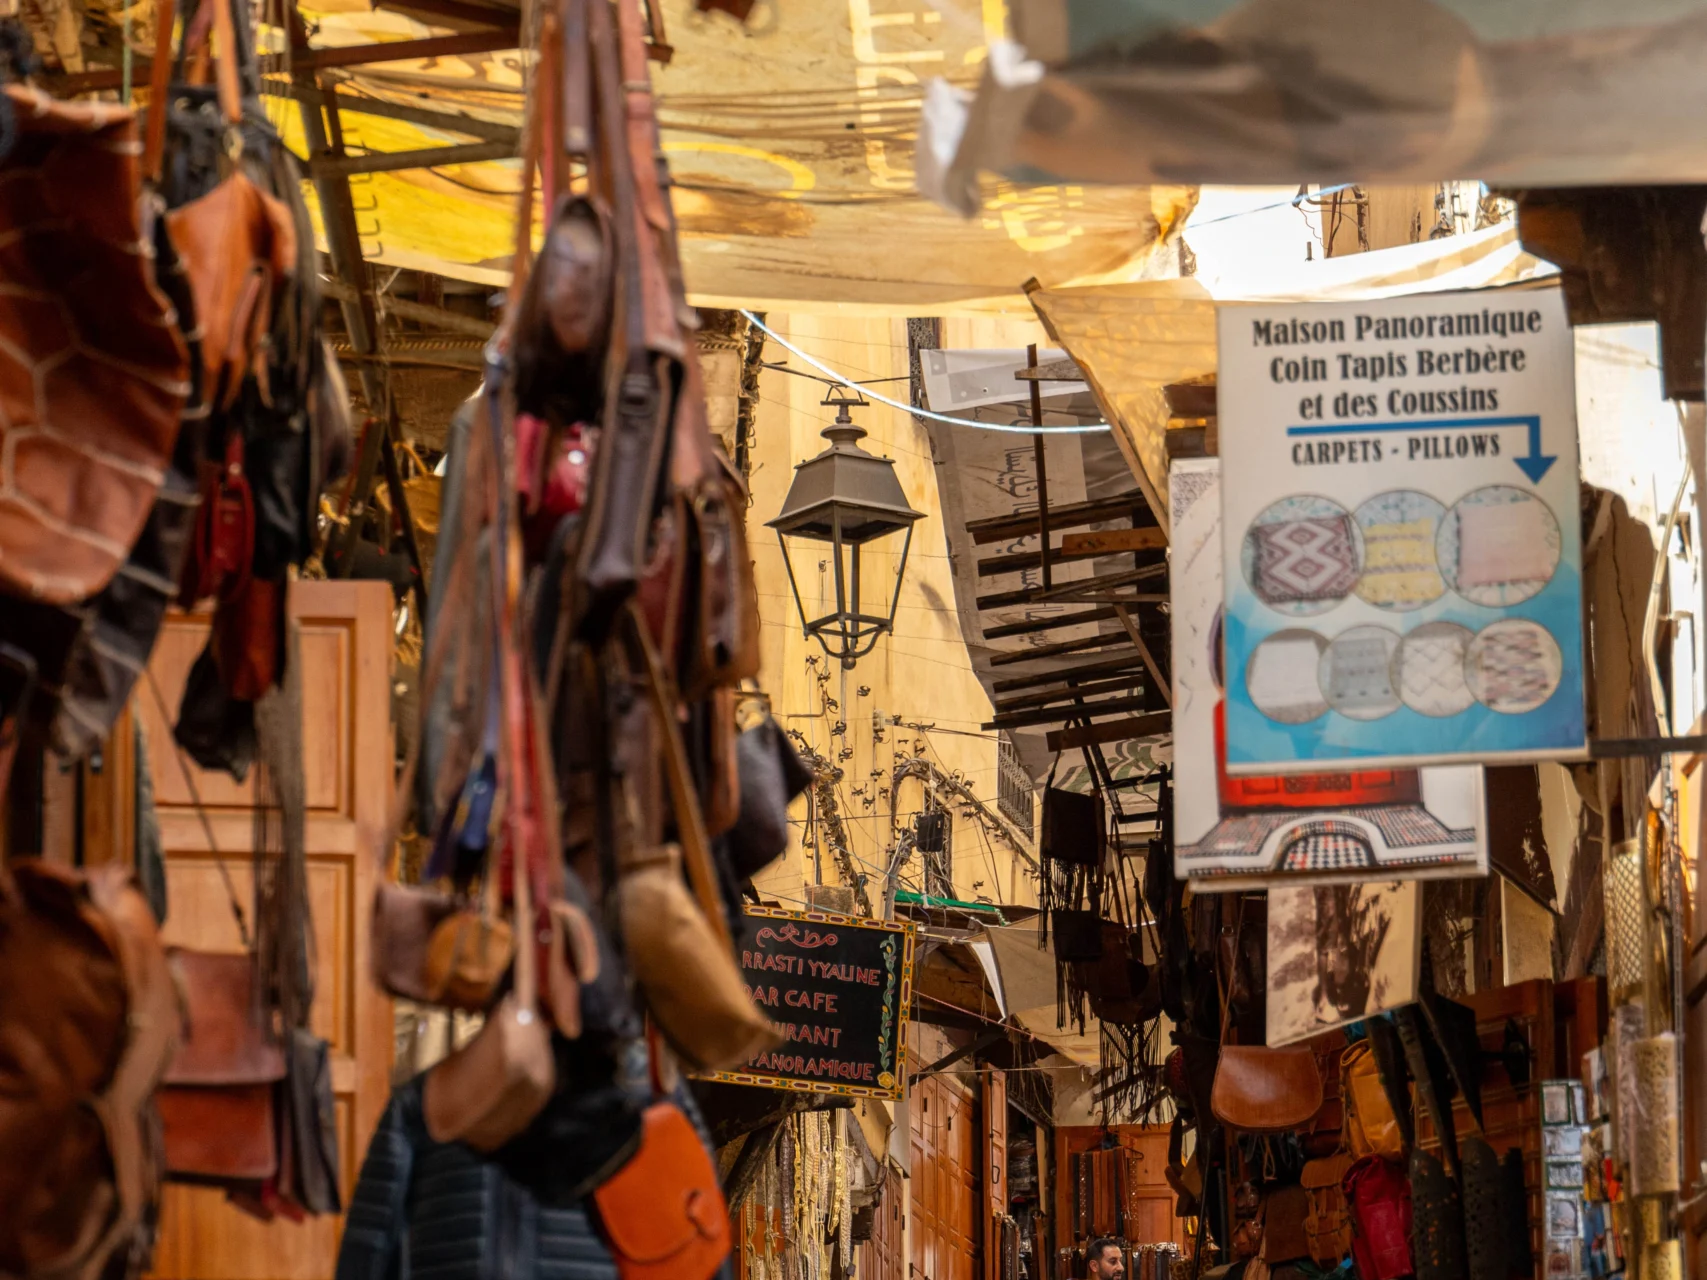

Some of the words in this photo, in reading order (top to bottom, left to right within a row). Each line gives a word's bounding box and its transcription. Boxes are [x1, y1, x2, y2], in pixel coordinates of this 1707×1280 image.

[1251, 318, 1346, 347] Maison
[1355, 308, 1542, 341] Panoramique
[1270, 355, 1328, 383] Coin
[1336, 350, 1408, 382] Tapis
[1416, 343, 1526, 376] Berbère
[1299, 395, 1324, 420] et
[1333, 391, 1378, 418] des
[1387, 386, 1499, 415] Coussins
[1291, 439, 1382, 466] CARPETS
[1408, 433, 1501, 461] PILLOWS
[756, 922, 839, 948] مطعم
[785, 990, 838, 1013] CAFE
[748, 1051, 875, 1080] PANORAMIQUE
